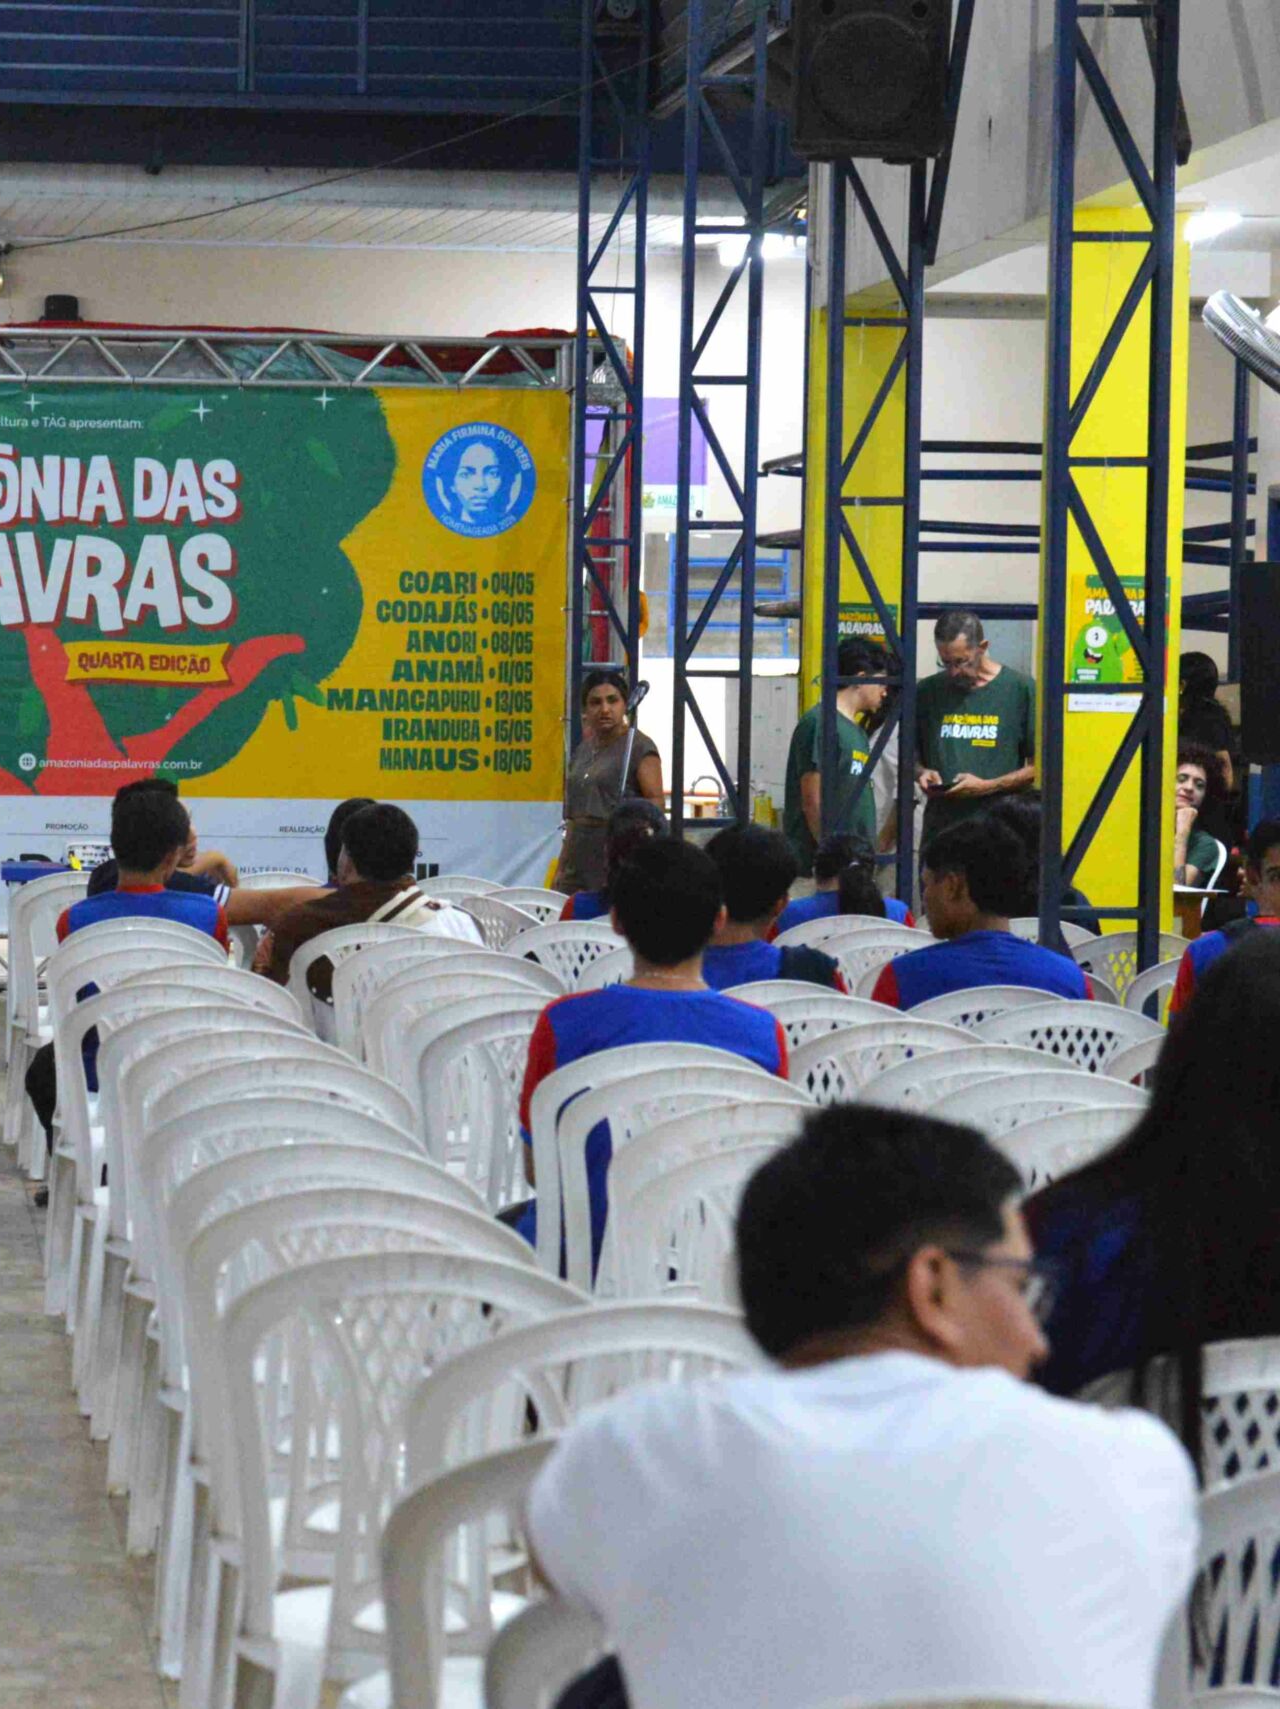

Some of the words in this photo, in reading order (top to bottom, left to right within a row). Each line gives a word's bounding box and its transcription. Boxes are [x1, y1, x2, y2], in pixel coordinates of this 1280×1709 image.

[31, 418, 40, 428] e
[426, 437, 454, 470] MARIA
[451, 425, 496, 442] FIRMINA
[496, 431, 518, 449] DOS
[513, 445, 532, 471] REIS
[133, 457, 236, 522] DAS
[398, 571, 477, 594] COARI
[490, 572, 534, 597] 04/05
[376, 595, 478, 623] CODAJÁS
[490, 601, 534, 627] 06/05
[406, 630, 477, 653] ANORI
[490, 631, 534, 656] 08/05
[78, 651, 145, 672] QUARTA
[149, 654, 211, 675] EDIÇÃO
[327, 688, 481, 712] MANACAPURU
[495, 690, 533, 715] 13/05
[382, 718, 480, 741] IRANDUBA
[494, 719, 533, 744] 15/05
[940, 723, 998, 739] PALAVRAS
[39, 758, 202, 771] amazoniadaspalavras.com.br
[379, 748, 480, 771] MANAUS
[493, 749, 532, 774] 18/05
[45, 822, 89, 831] PROMOÇÃO
[279, 824, 325, 834] REALIZAÇÃO
